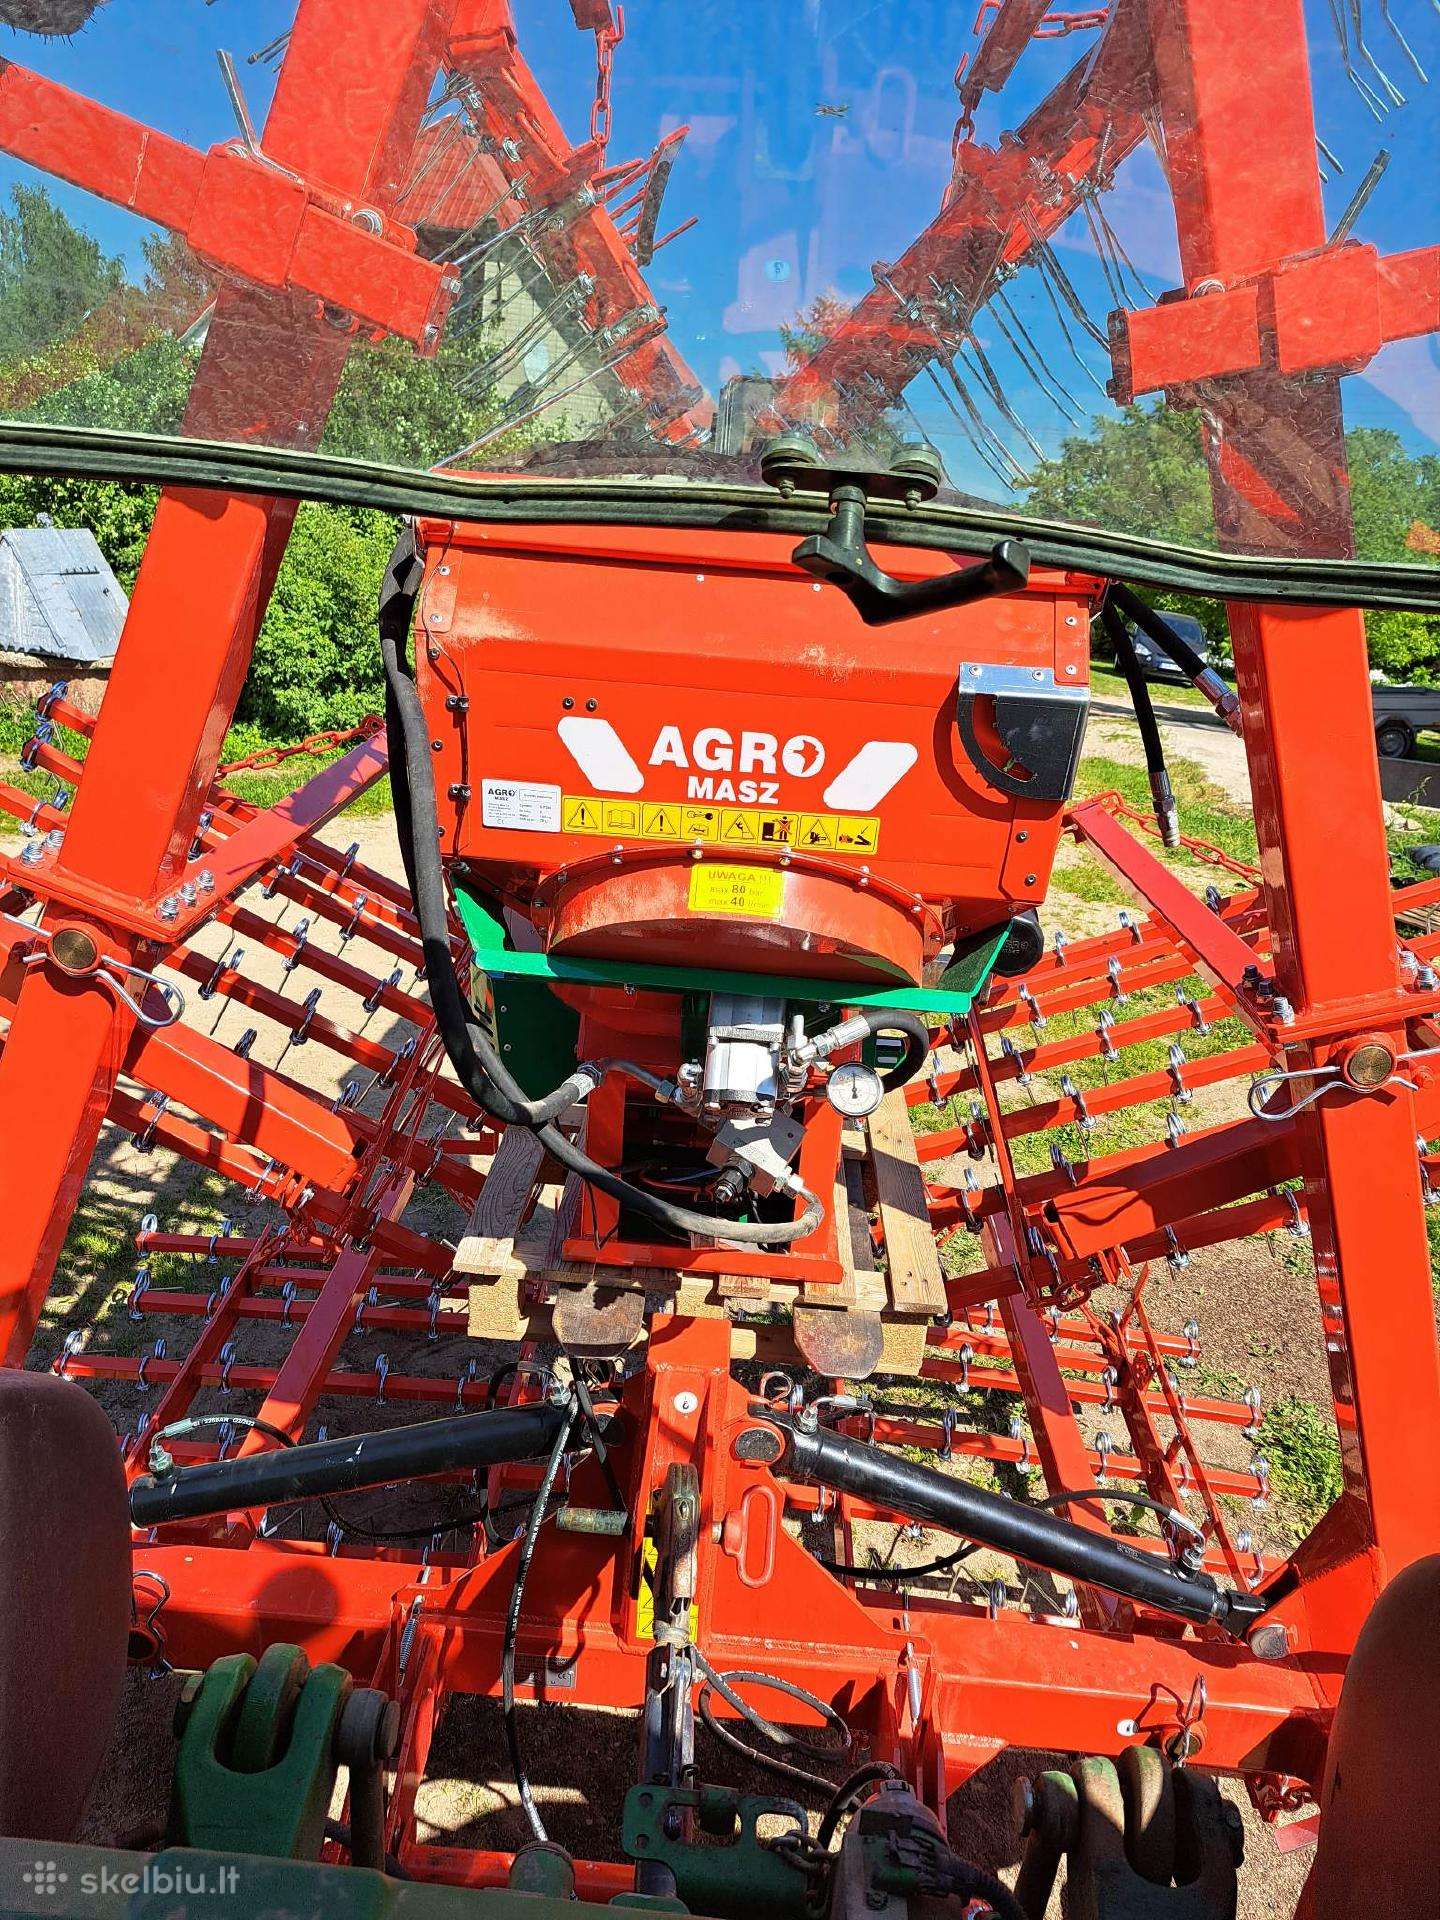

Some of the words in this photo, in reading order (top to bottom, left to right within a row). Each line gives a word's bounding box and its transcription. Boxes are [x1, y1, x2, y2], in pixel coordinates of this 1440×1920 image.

[648, 725, 825, 778] AGRO
[487, 788, 517, 797] AGRO
[687, 775, 780, 805] MASZ
[708, 870, 755, 881] UWAGA
[731, 884, 746, 894] 80
[730, 896, 745, 907] 40
